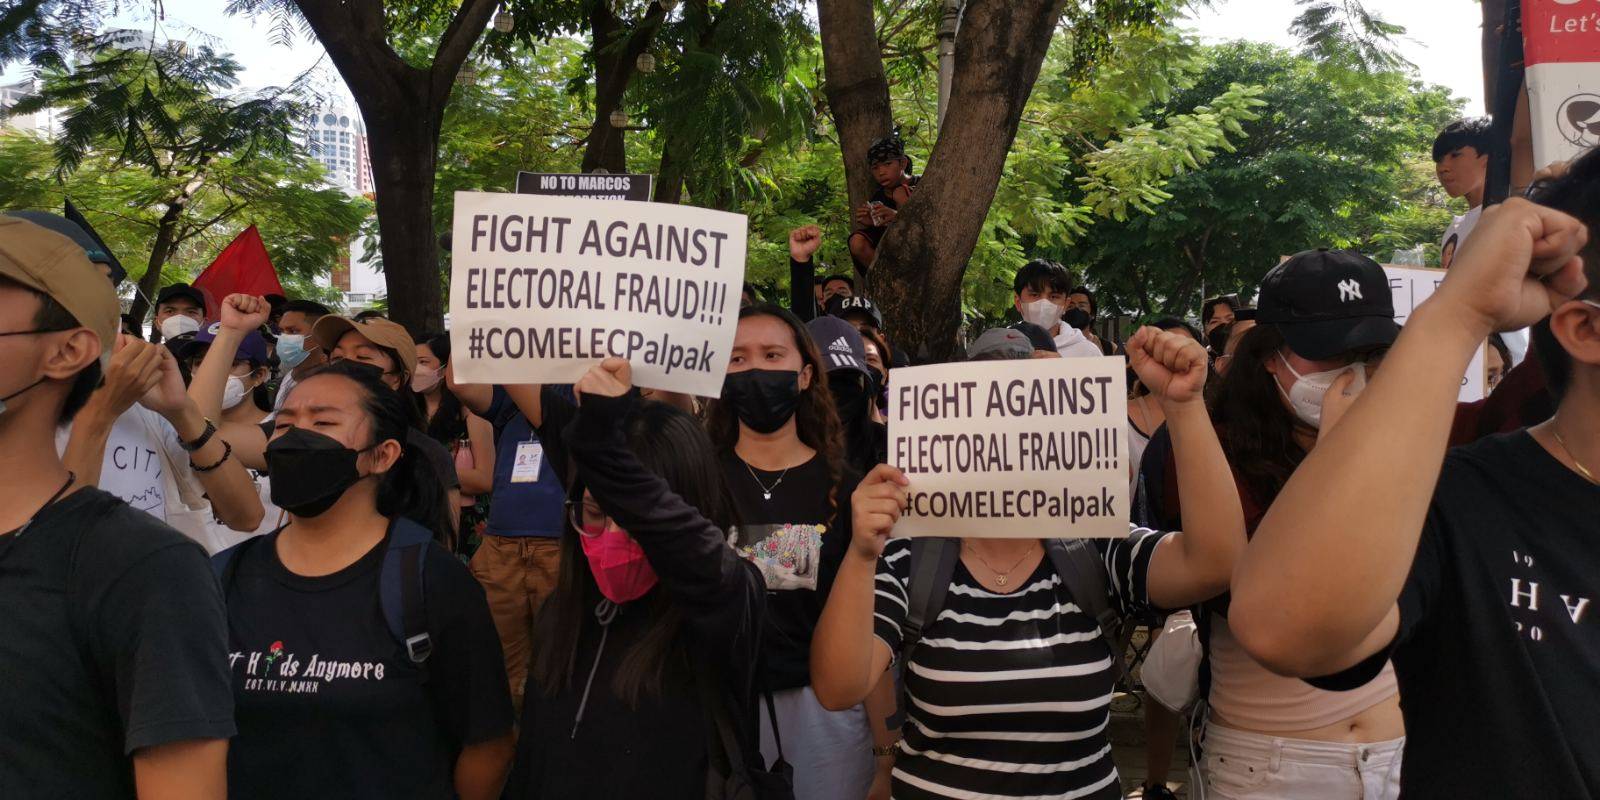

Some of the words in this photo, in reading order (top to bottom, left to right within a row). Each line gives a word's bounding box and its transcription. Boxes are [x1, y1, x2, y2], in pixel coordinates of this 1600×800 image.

[541, 176, 557, 189] NO
[560, 177, 575, 190] TO
[578, 177, 631, 190] MARCOS
[471, 214, 571, 254] FIGHT
[579, 219, 728, 268] AGAINST
[466, 267, 606, 310] ELECTORAL
[614, 272, 727, 326] FRAUD!!!
[841, 296, 872, 309] GAP
[1337, 278, 1363, 302] NY
[469, 327, 715, 374] #COMELECPalpak
[828, 344, 853, 354] adidas
[899, 381, 977, 421] FIGHT
[986, 376, 1112, 417] AGAINST
[113, 446, 161, 479] CIT
[896, 432, 1013, 474] ELECTORAL
[1019, 428, 1118, 471] FRAUD!!!
[901, 487, 1116, 523] #COMELECPalpak
[302, 653, 385, 682] Anymore
